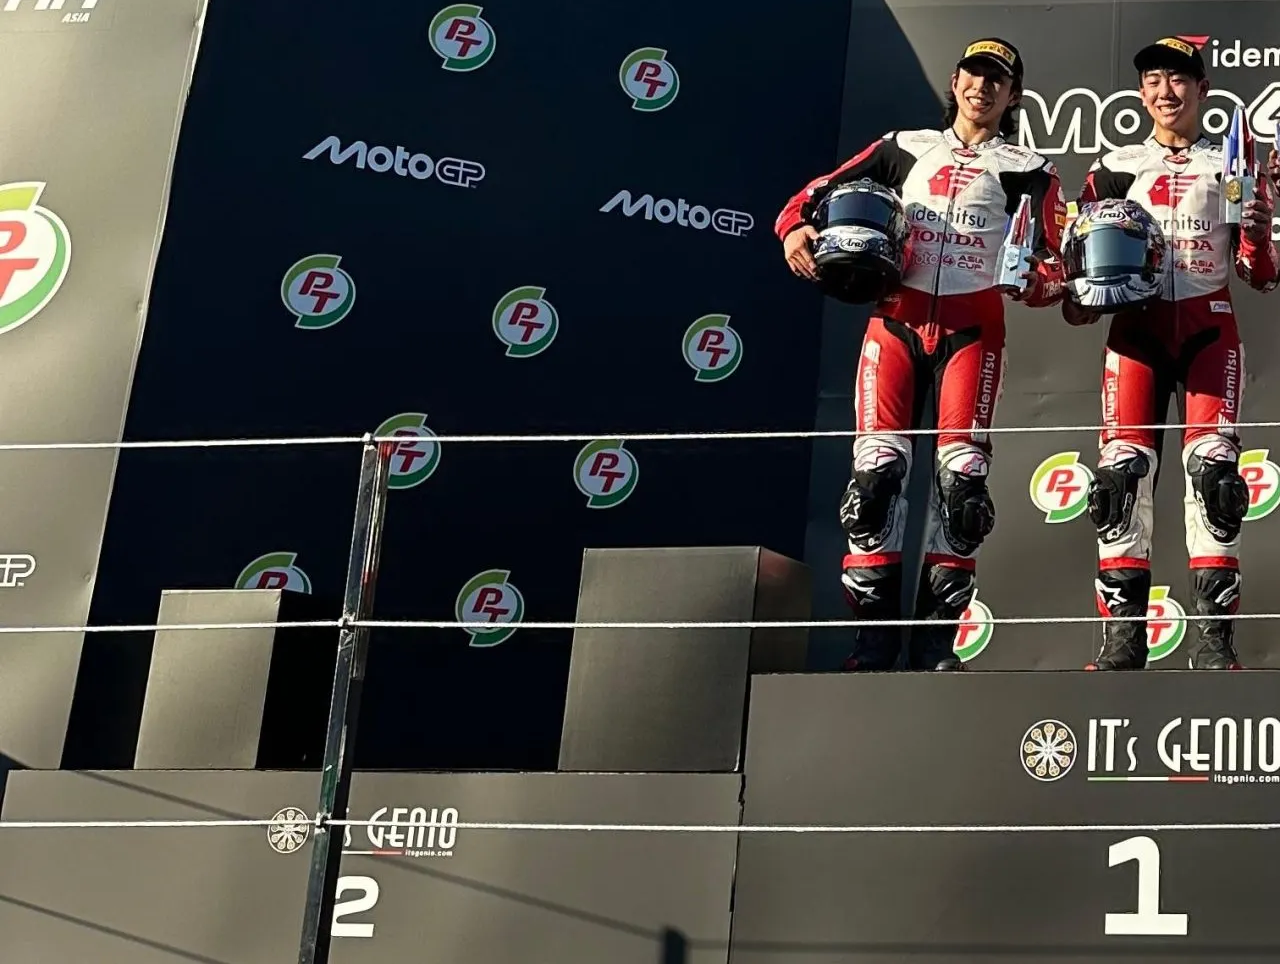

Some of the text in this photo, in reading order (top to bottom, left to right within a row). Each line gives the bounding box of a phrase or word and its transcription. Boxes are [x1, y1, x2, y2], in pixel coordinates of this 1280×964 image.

[61, 12, 91, 23] ASIA
[444, 18, 482, 57] PT
[634, 61, 668, 98] PT
[302, 135, 486, 188] MotoGP
[599, 189, 755, 237] MotoGP
[298, 270, 342, 313] PT
[507, 303, 546, 344] PT
[697, 328, 733, 367] PT
[978, 351, 996, 419] idemitsu
[1221, 349, 1237, 414] idemitsu
[588, 452, 626, 492] PT
[1045, 468, 1081, 507] PT
[1214, 773, 1280, 785] itsgenio.com
[331, 875, 380, 938] 2
[1105, 836, 1188, 936] 1
